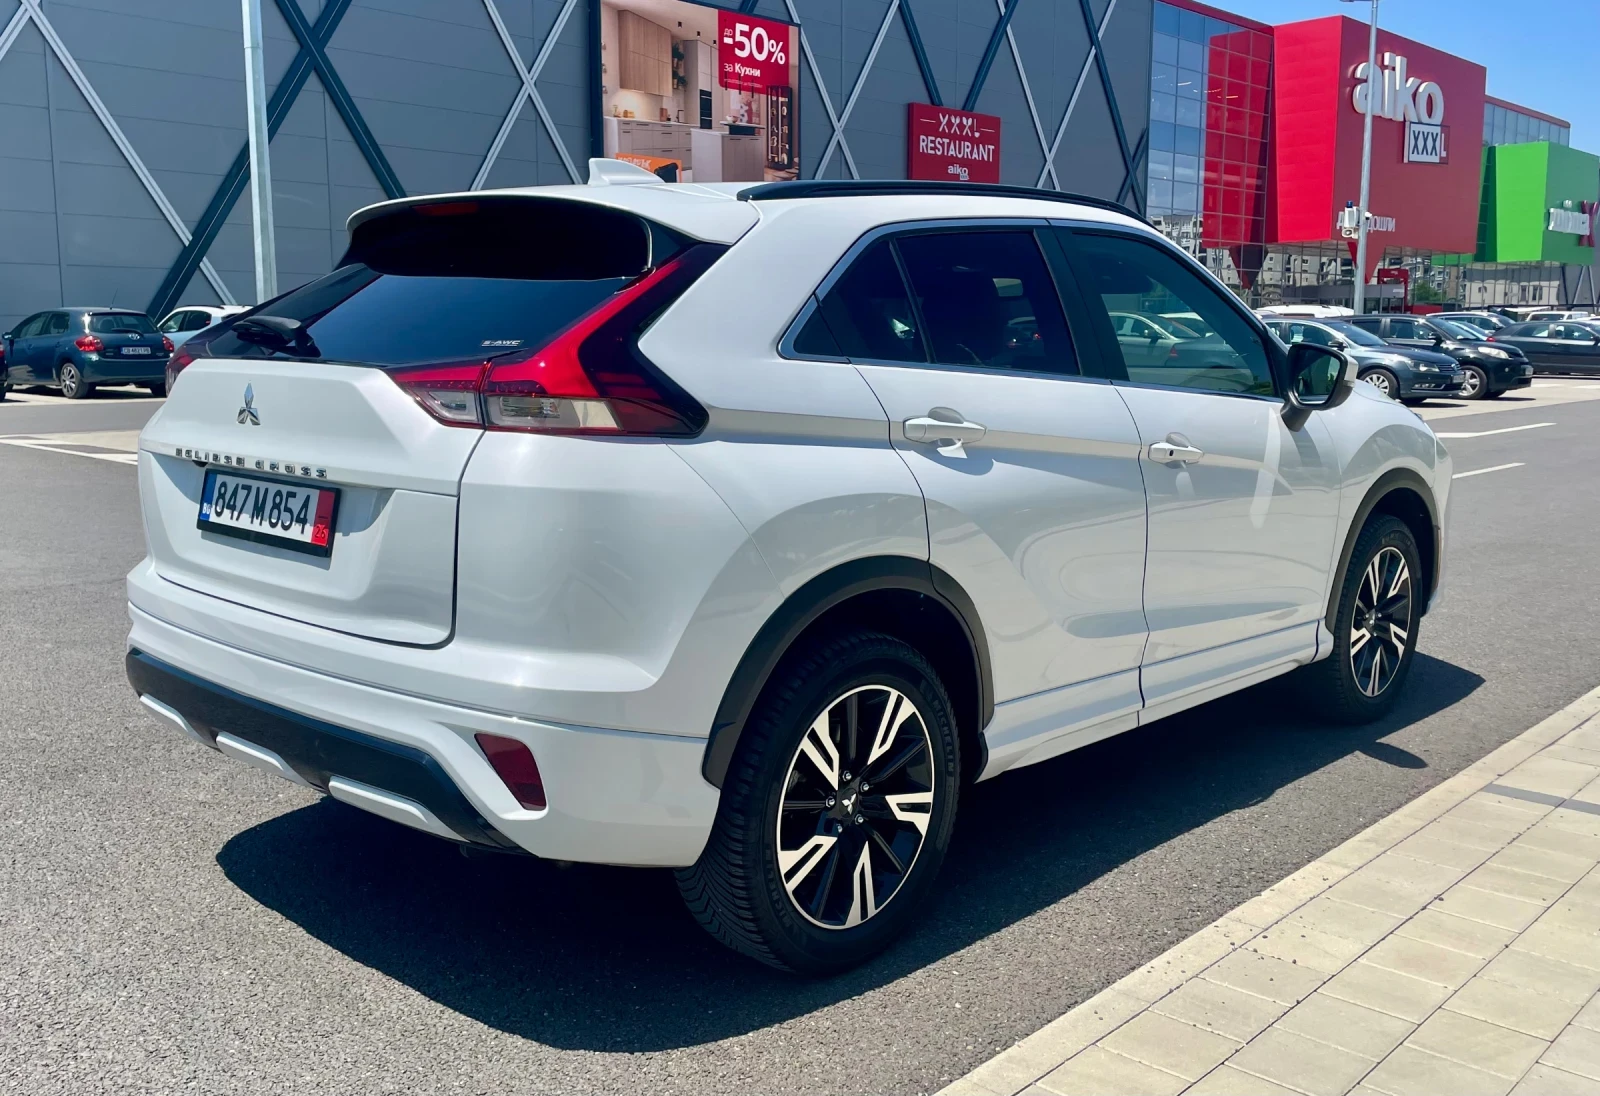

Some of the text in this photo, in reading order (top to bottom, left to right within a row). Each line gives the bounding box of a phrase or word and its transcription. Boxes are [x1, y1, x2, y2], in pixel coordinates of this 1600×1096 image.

[723, 22, 786, 65] -50%
[723, 63, 761, 77] за Кухни
[1352, 51, 1445, 125] aiko
[919, 134, 995, 162] RESTAURANT
[947, 163, 969, 176] aiko
[202, 503, 212, 515] BG
[314, 525, 327, 539] 26
